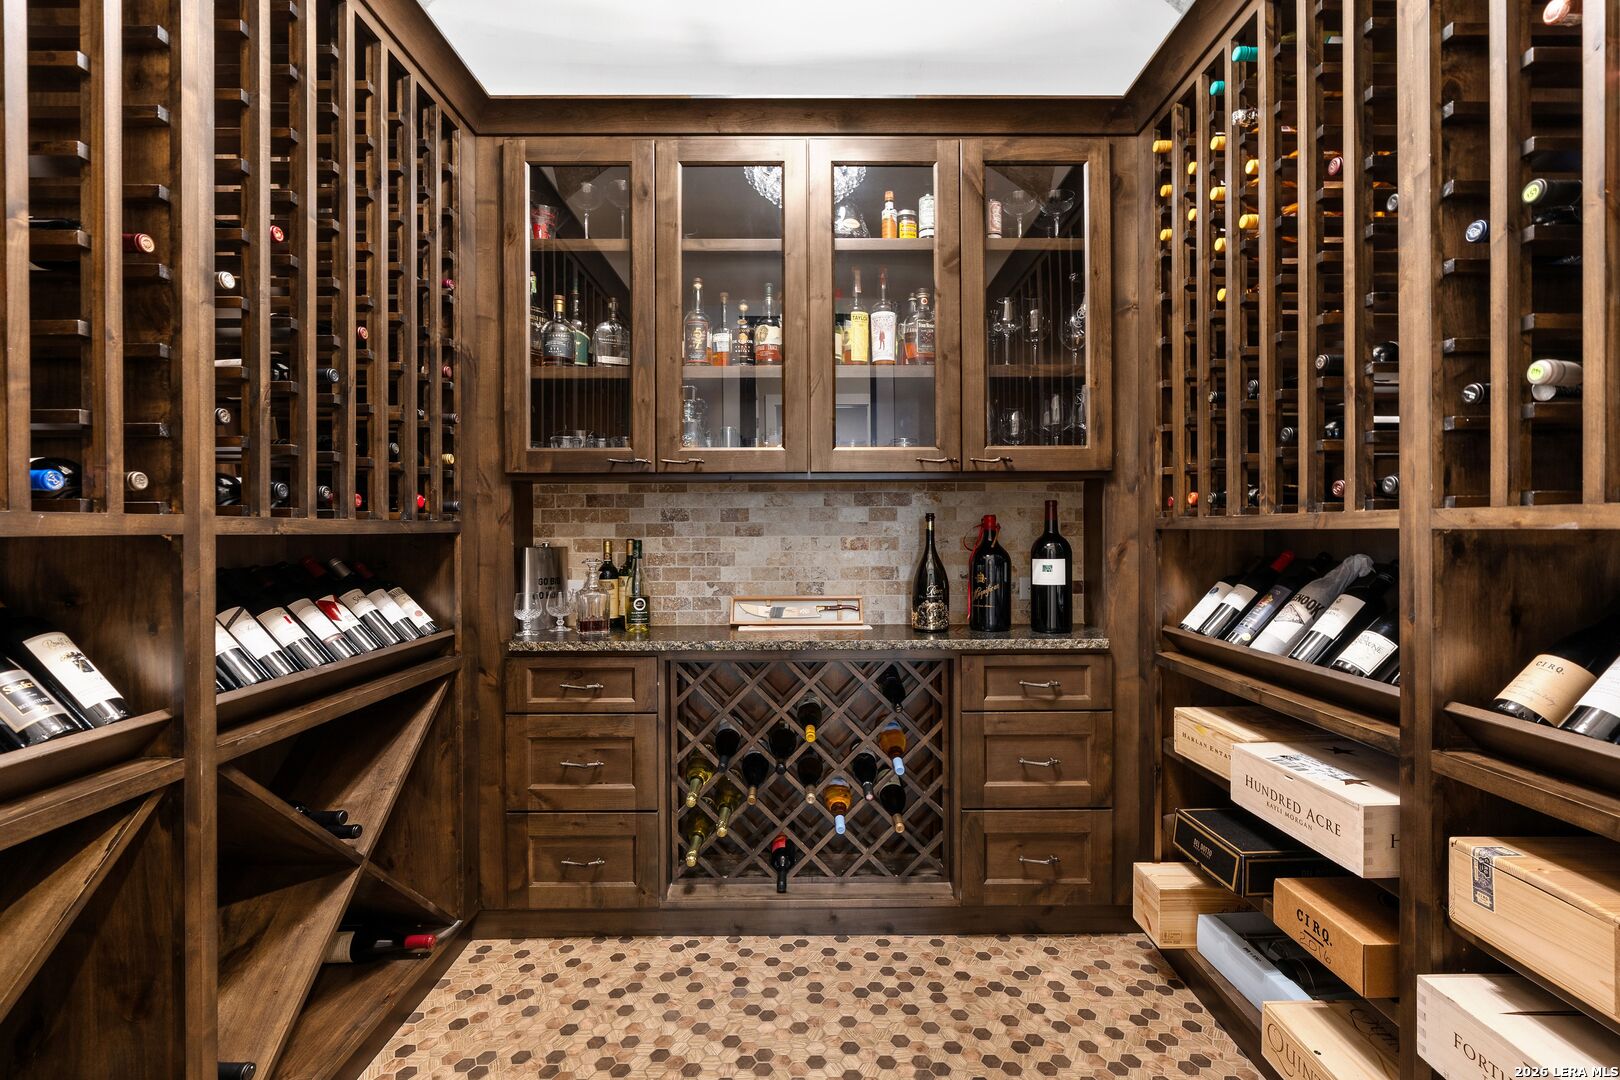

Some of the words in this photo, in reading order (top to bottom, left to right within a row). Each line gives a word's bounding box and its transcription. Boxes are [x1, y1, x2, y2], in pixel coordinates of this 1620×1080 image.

[1209, 745, 1232, 761] ESTAT
[1245, 774, 1302, 815] HUNDRED
[1306, 808, 1341, 837] ACRE
[1285, 811, 1313, 831] MORGAN
[1296, 908, 1333, 947] CIRQ.
[1299, 931, 1332, 965] 2016
